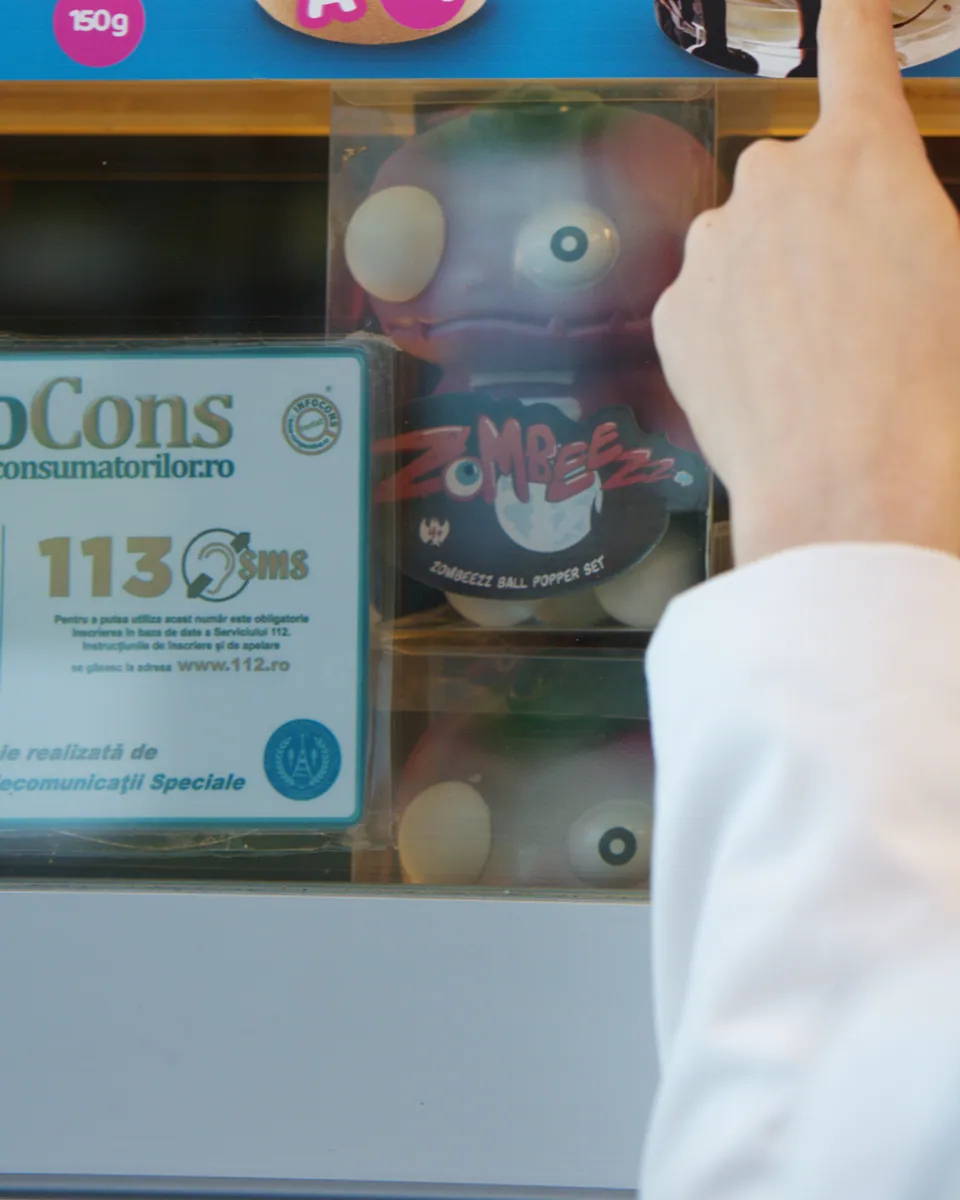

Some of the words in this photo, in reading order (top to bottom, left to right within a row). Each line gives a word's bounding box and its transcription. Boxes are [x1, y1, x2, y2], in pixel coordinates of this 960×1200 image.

[69, 8, 129, 37] 150g
[0, 453, 235, 480] onsumatorilor.ro
[38, 536, 173, 598] 113
[497, 576, 528, 589] BALL
[532, 566, 580, 588] POPPER
[582, 555, 605, 576] SET
[54, 614, 88, 624] Pentru
[230, 615, 252, 624] este
[254, 613, 310, 626] obligatorie
[165, 627, 178, 638] de
[152, 640, 165, 651] de
[227, 640, 240, 651] de
[177, 657, 291, 672] www.112.ro
[26, 743, 124, 761] realizată
[130, 743, 158, 760] de
[149, 773, 246, 794] Speciale
